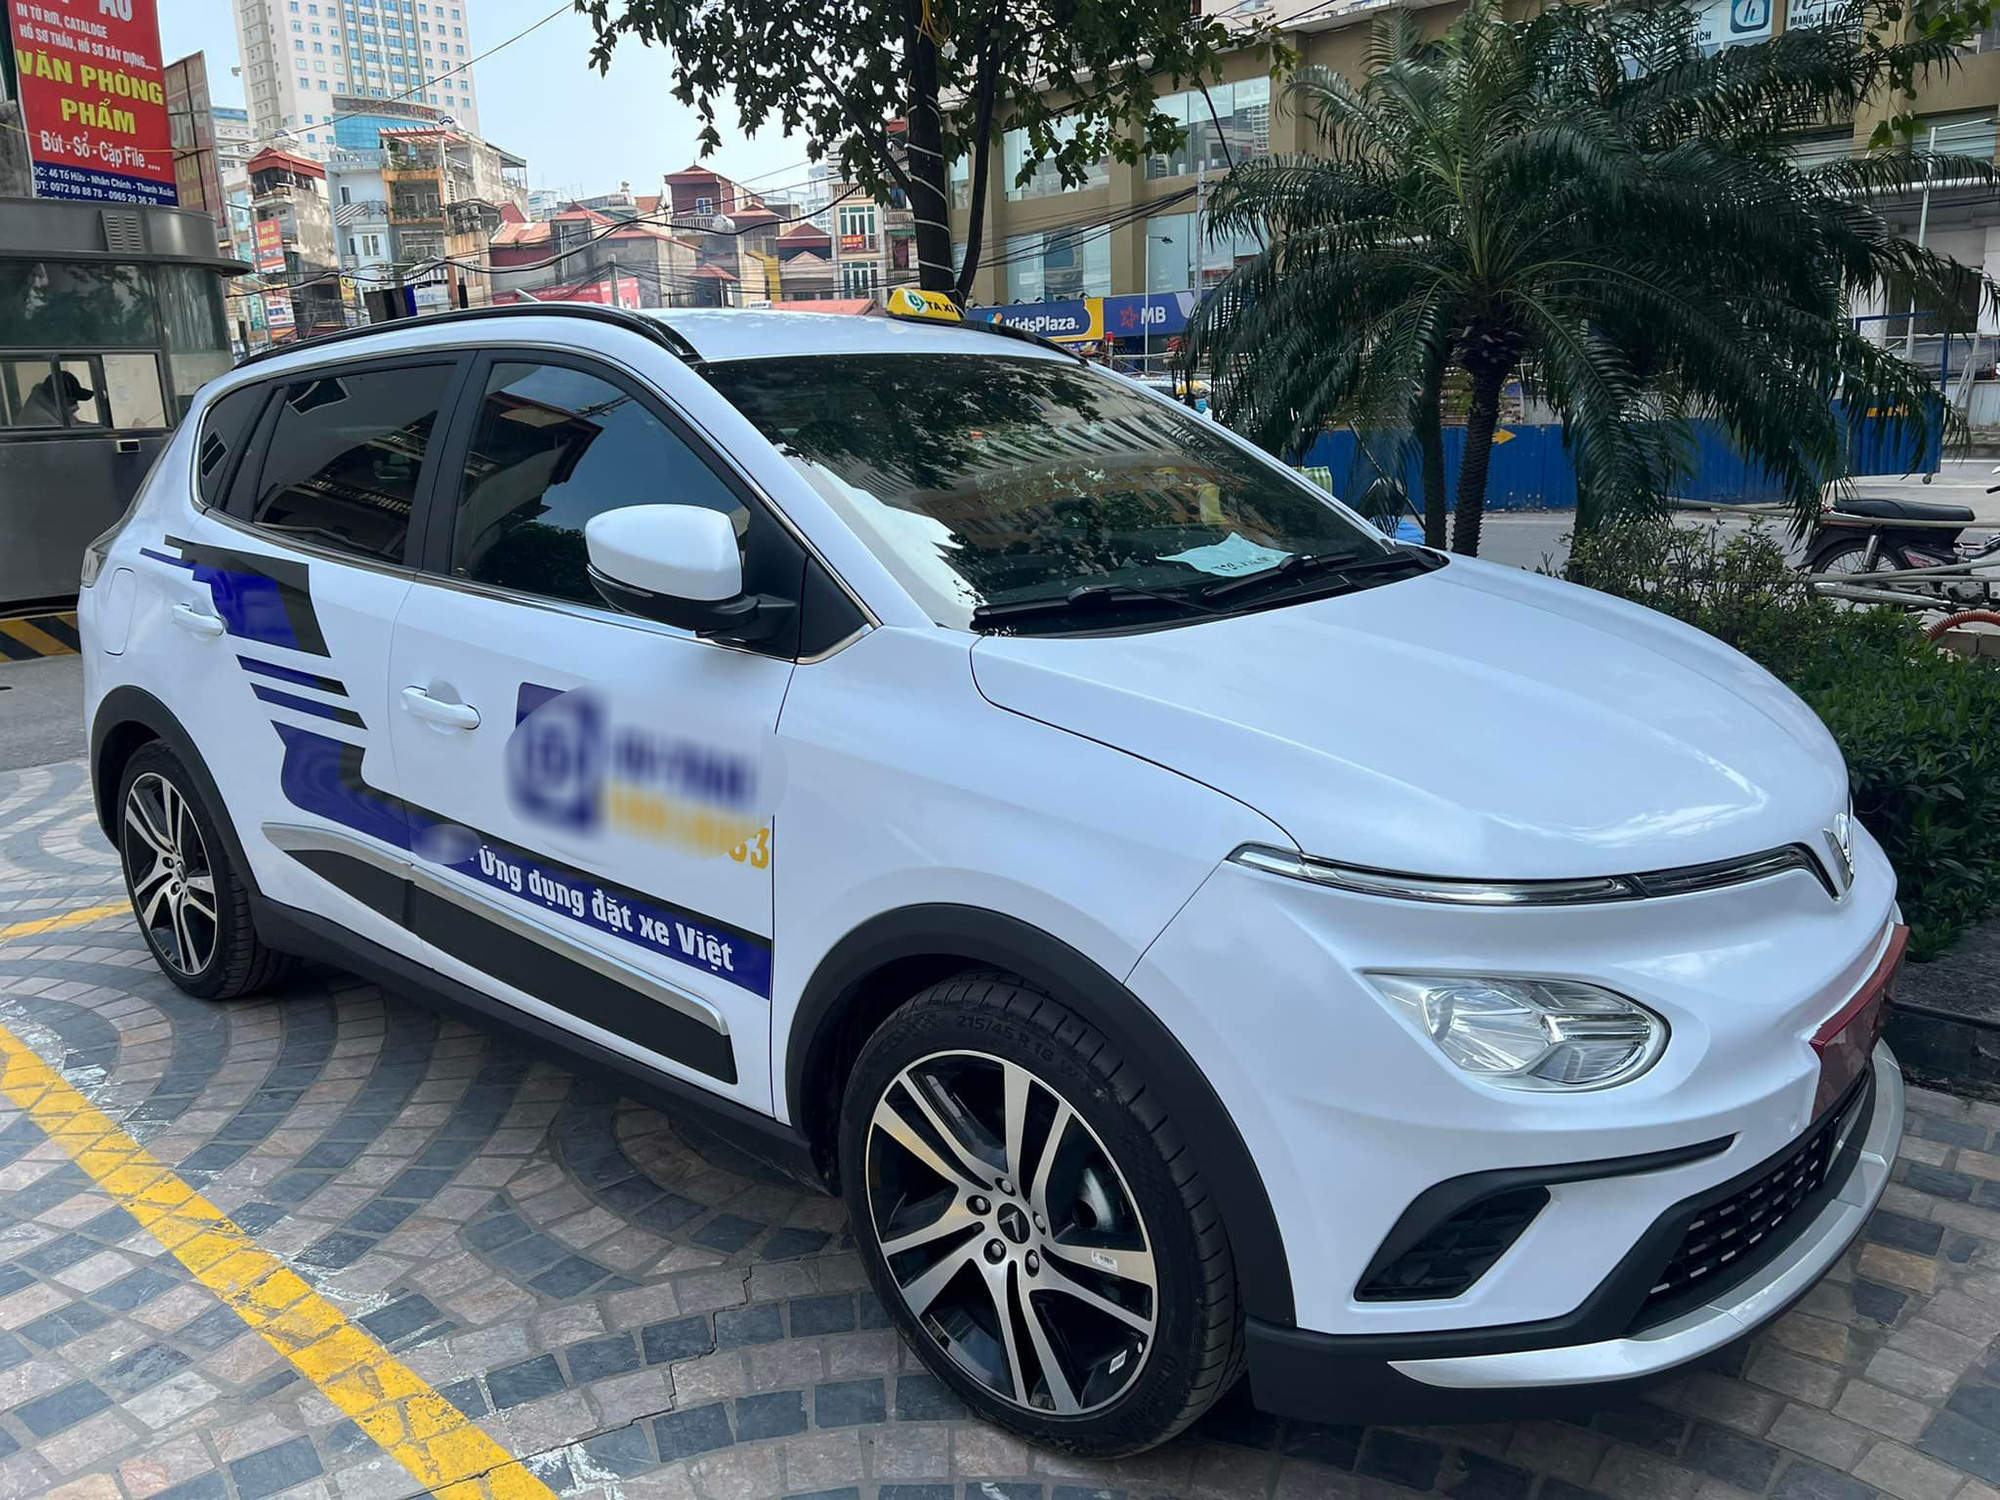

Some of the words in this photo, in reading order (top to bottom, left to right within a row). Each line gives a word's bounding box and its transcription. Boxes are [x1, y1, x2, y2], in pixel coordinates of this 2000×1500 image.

[64, 15, 108, 39] CATALOGE
[16, 48, 74, 84] VĂN
[80, 65, 164, 106] PHÒNG
[61, 98, 136, 135] PHẨM
[40, 130, 64, 154] Bút
[73, 131, 90, 158] Sổ
[99, 141, 122, 168] Cặp
[124, 146, 146, 168] File
[137, 182, 158, 195] Thanh
[1140, 306, 1166, 325] MB
[478, 845, 522, 893] Ứng
[528, 868, 586, 918] dụng
[591, 888, 634, 932] đặt
[638, 913, 670, 946] xe
[675, 921, 735, 972] Việt
